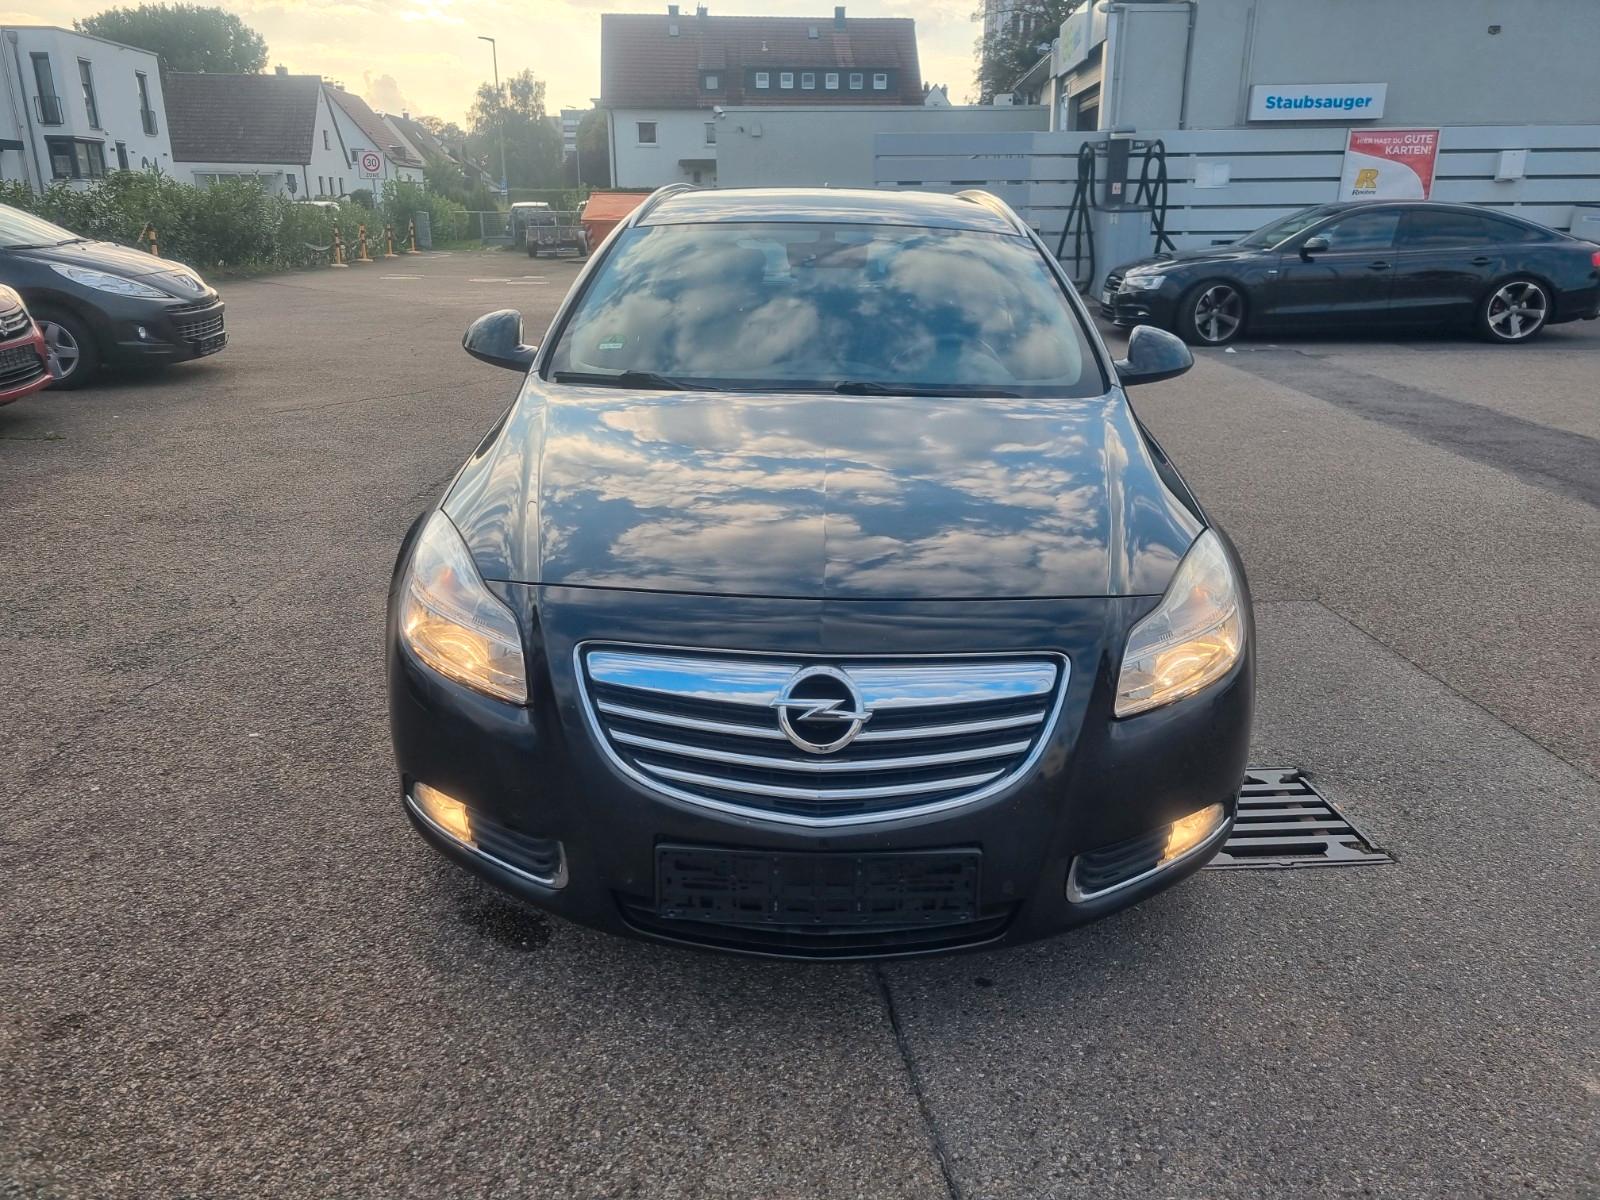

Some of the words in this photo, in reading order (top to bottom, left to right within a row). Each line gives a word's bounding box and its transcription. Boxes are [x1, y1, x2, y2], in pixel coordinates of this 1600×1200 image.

[1265, 95, 1372, 110] Staubsauger
[1404, 134, 1433, 144] GUTE
[1385, 145, 1432, 155] KARTEN!
[366, 158, 377, 167] 30
